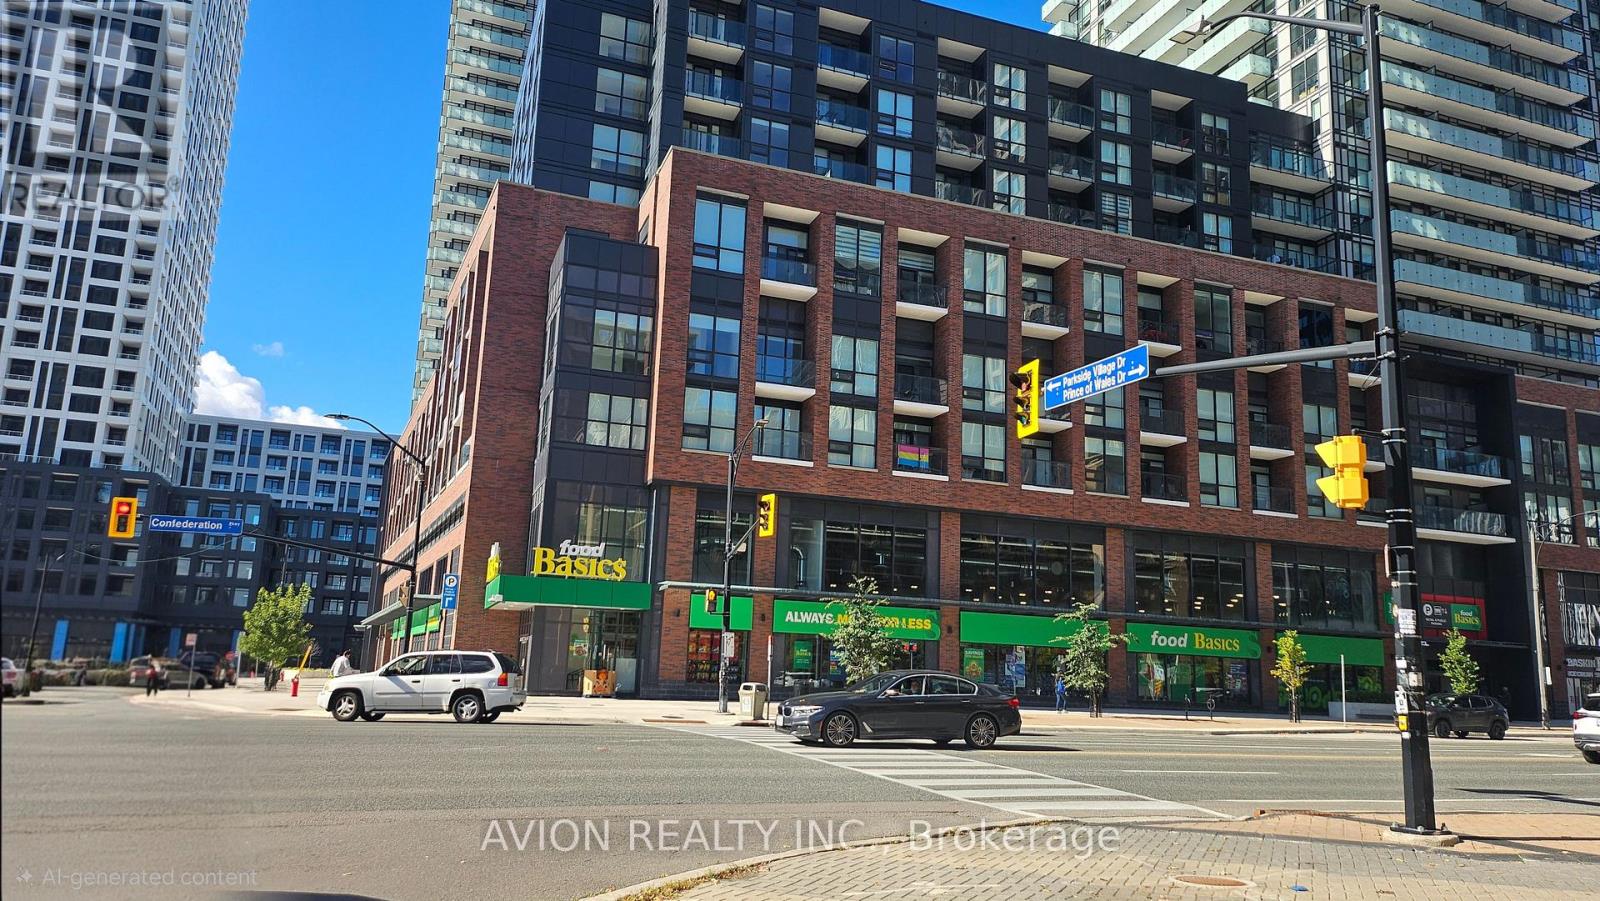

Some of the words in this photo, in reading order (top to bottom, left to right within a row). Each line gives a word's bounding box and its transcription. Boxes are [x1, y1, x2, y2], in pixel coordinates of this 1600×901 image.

[1063, 369, 1092, 387] Parkside
[1093, 363, 1116, 375] Village
[1117, 356, 1127, 369] Dr
[1063, 385, 1084, 401] Prince
[1085, 383, 1093, 394] of
[1094, 375, 1116, 391] Wales
[1117, 371, 1127, 383] Dr
[151, 518, 223, 530] Confederation
[560, 540, 606, 557] food
[532, 546, 627, 581] Basics
[785, 611, 834, 624] ALWAYS
[902, 618, 932, 630] LESS
[1455, 614, 1480, 625] Basics
[1151, 630, 1188, 648] food
[1194, 632, 1240, 652] Basics
[1566, 658, 1596, 668] BASKIN
